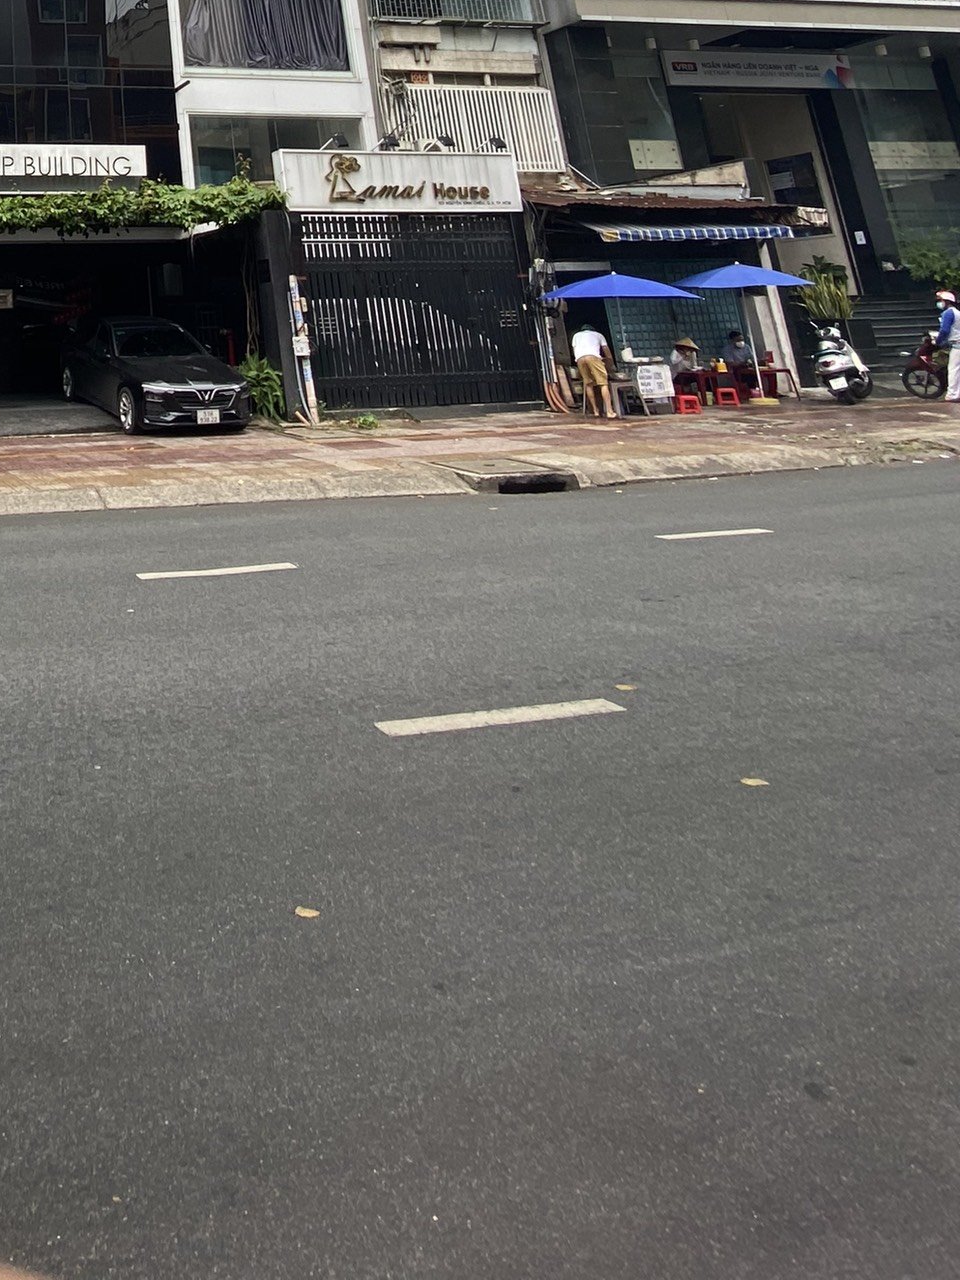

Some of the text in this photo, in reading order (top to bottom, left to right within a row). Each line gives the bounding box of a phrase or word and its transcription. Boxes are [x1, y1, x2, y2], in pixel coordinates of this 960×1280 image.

[674, 62, 696, 71] VRB
[24, 156, 133, 177] BUILDING
[433, 182, 490, 200] House
